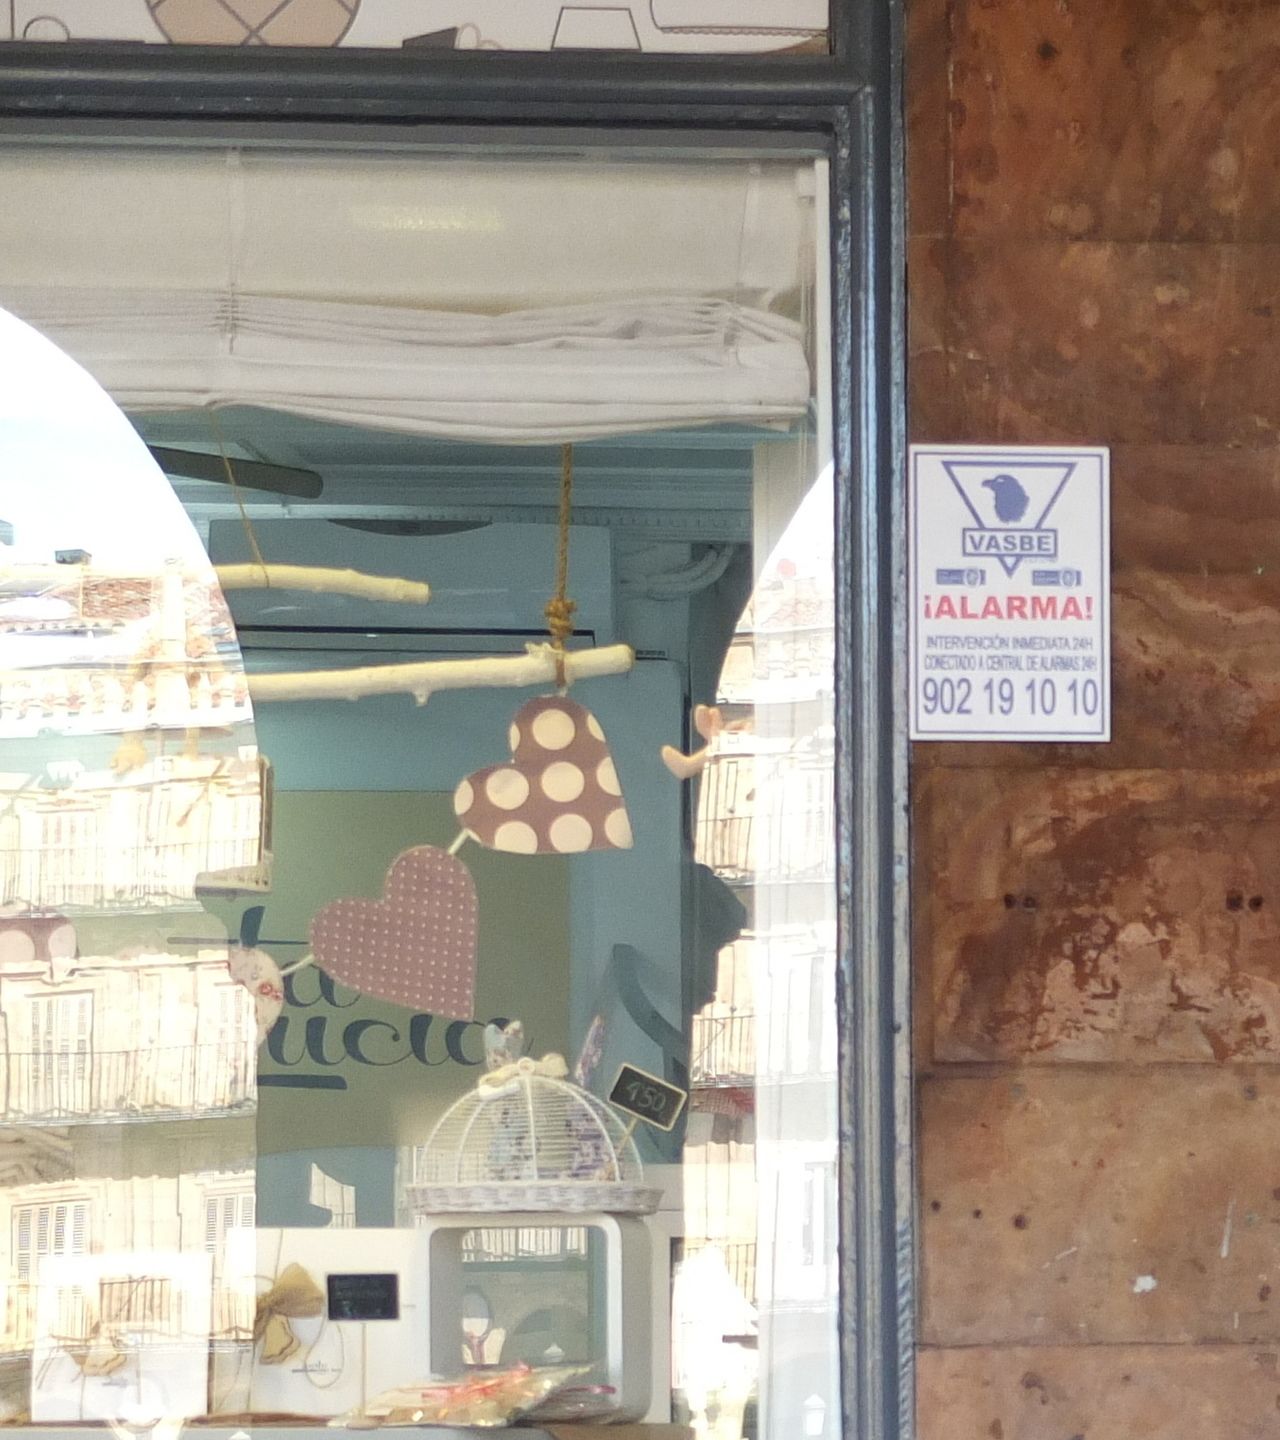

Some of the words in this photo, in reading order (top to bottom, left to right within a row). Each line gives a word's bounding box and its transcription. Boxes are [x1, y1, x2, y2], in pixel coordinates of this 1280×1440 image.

[967, 533, 1052, 553] VASBE
[924, 594, 1093, 621] ¡ALARMA!
[923, 677, 972, 715] 902
[983, 677, 1014, 716] 19
[1025, 677, 1056, 716] 10
[1067, 678, 1098, 716] 10
